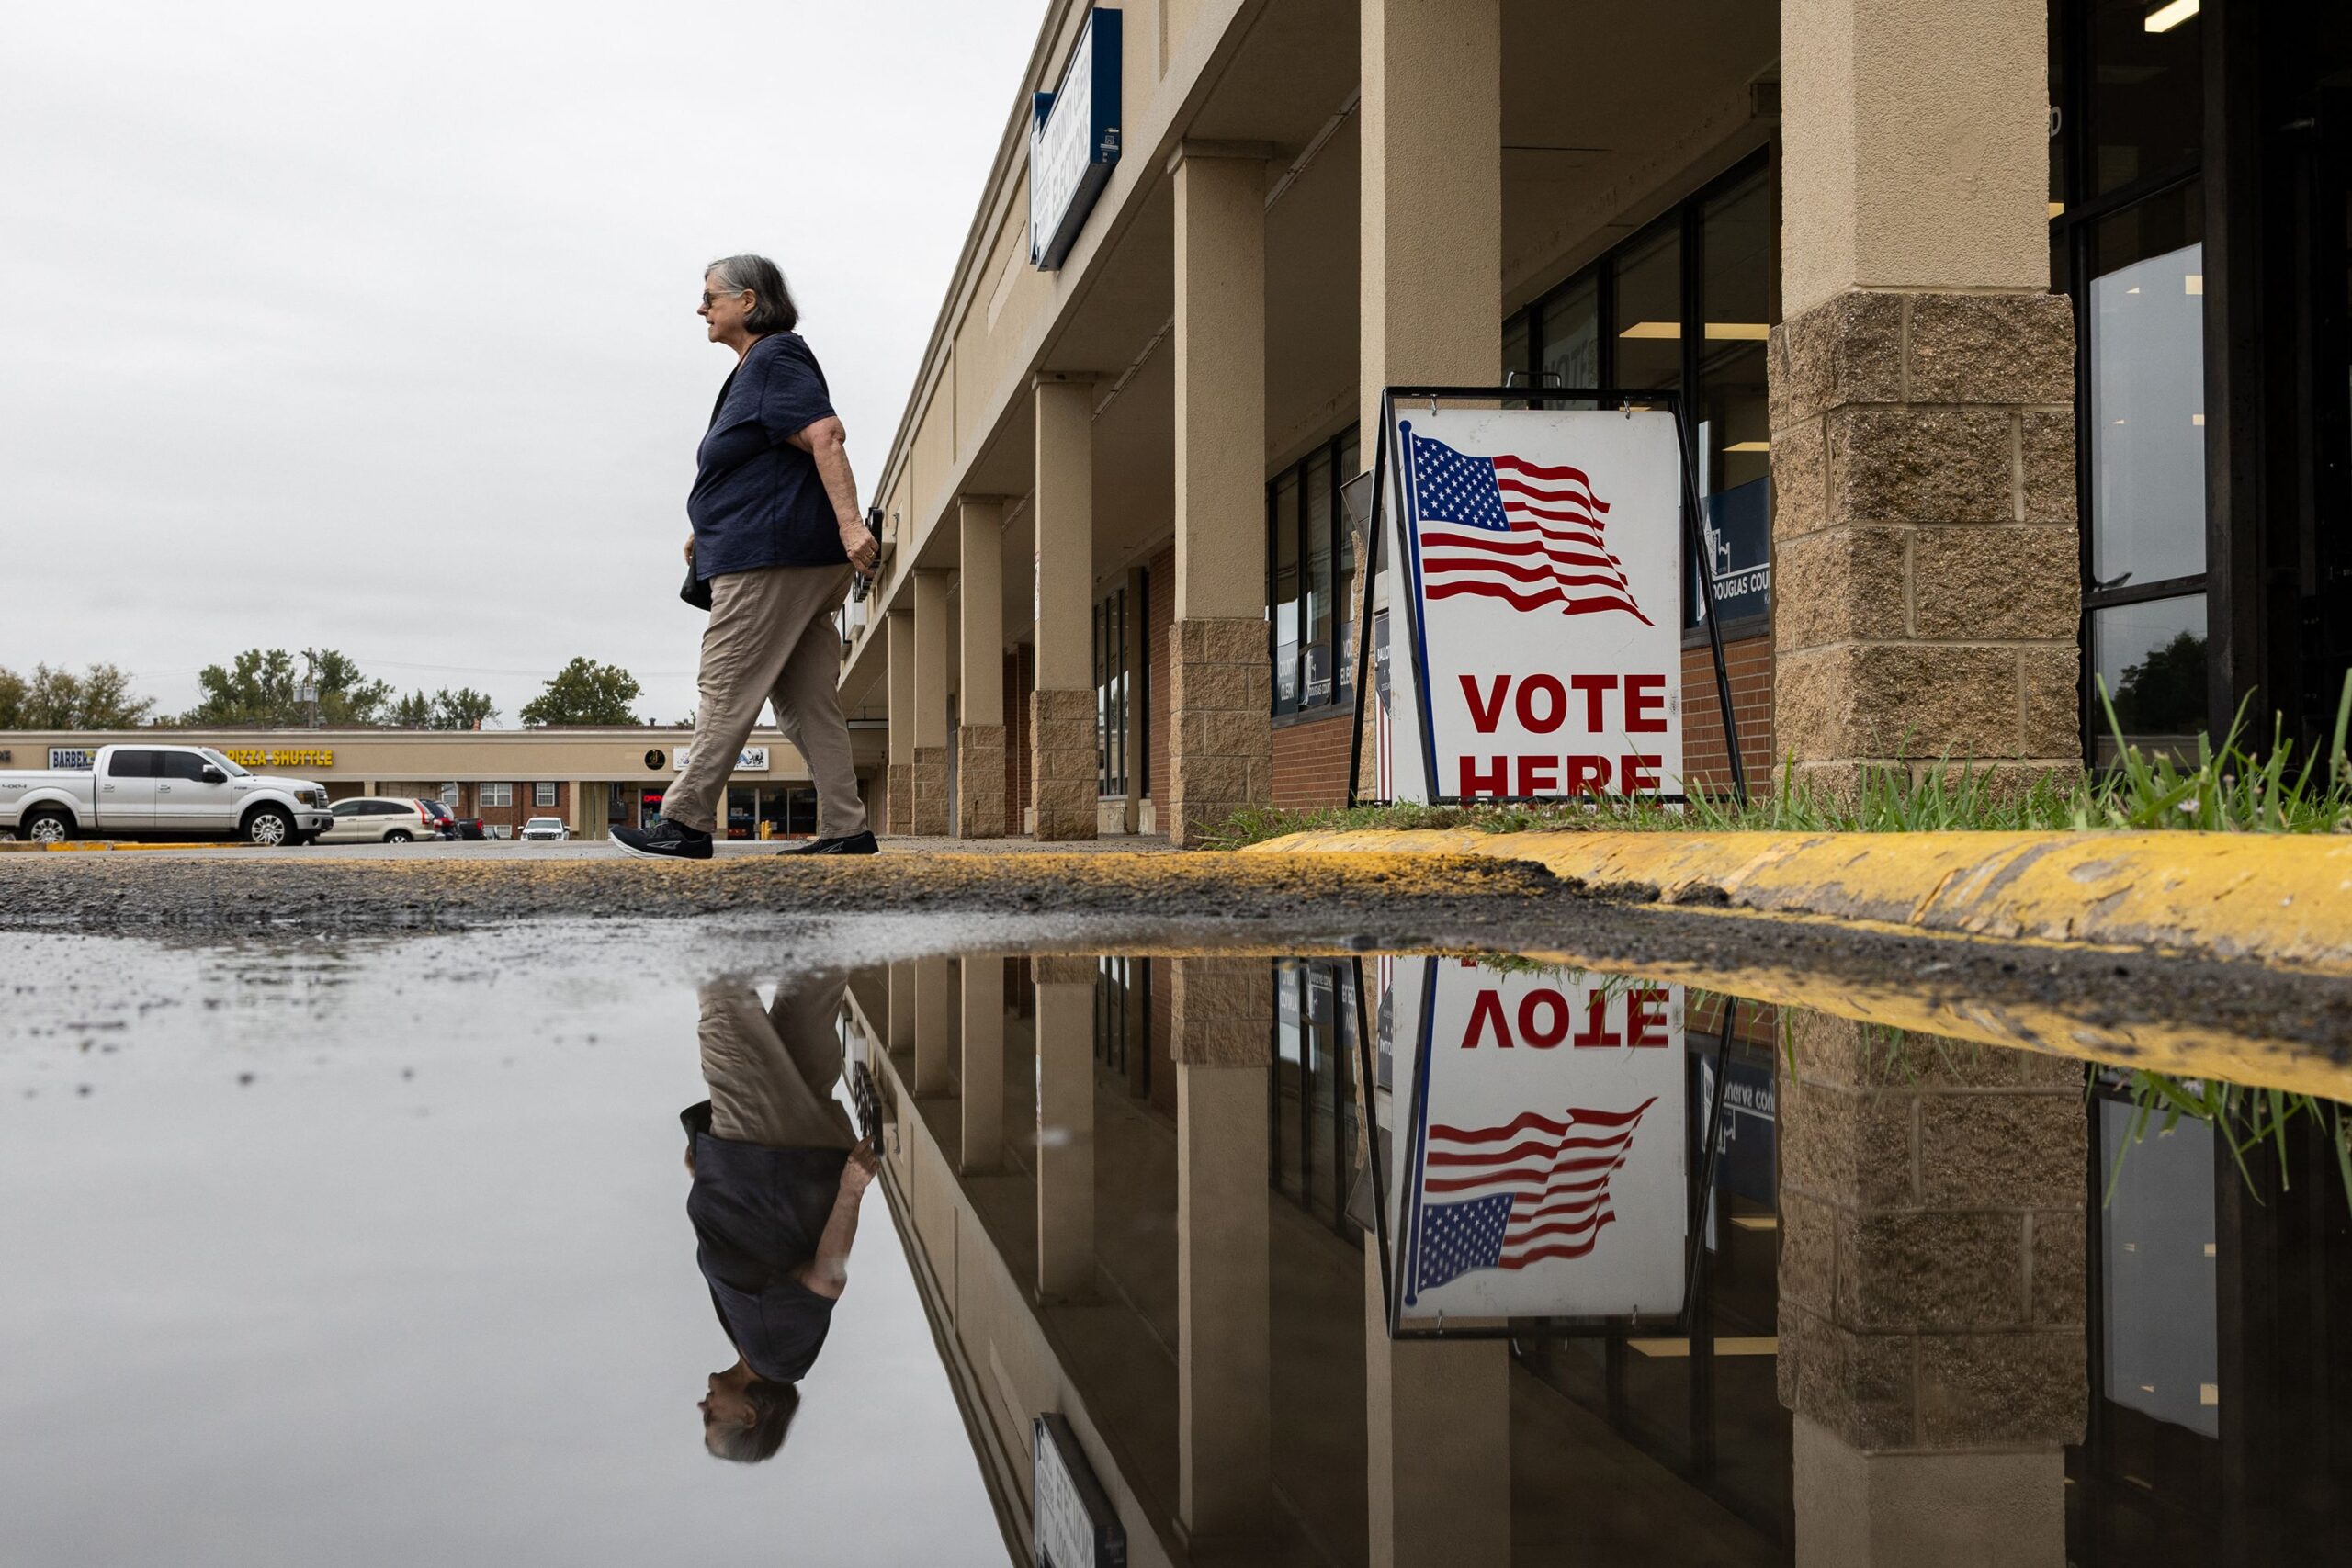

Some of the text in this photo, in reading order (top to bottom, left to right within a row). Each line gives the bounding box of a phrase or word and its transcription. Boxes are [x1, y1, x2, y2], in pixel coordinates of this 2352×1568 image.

[1458, 674, 1667, 733] VOTE
[53, 750, 87, 768] BARBER
[226, 750, 333, 766] PIZZA SHUTTLE
[1459, 754, 1663, 805] HERE
